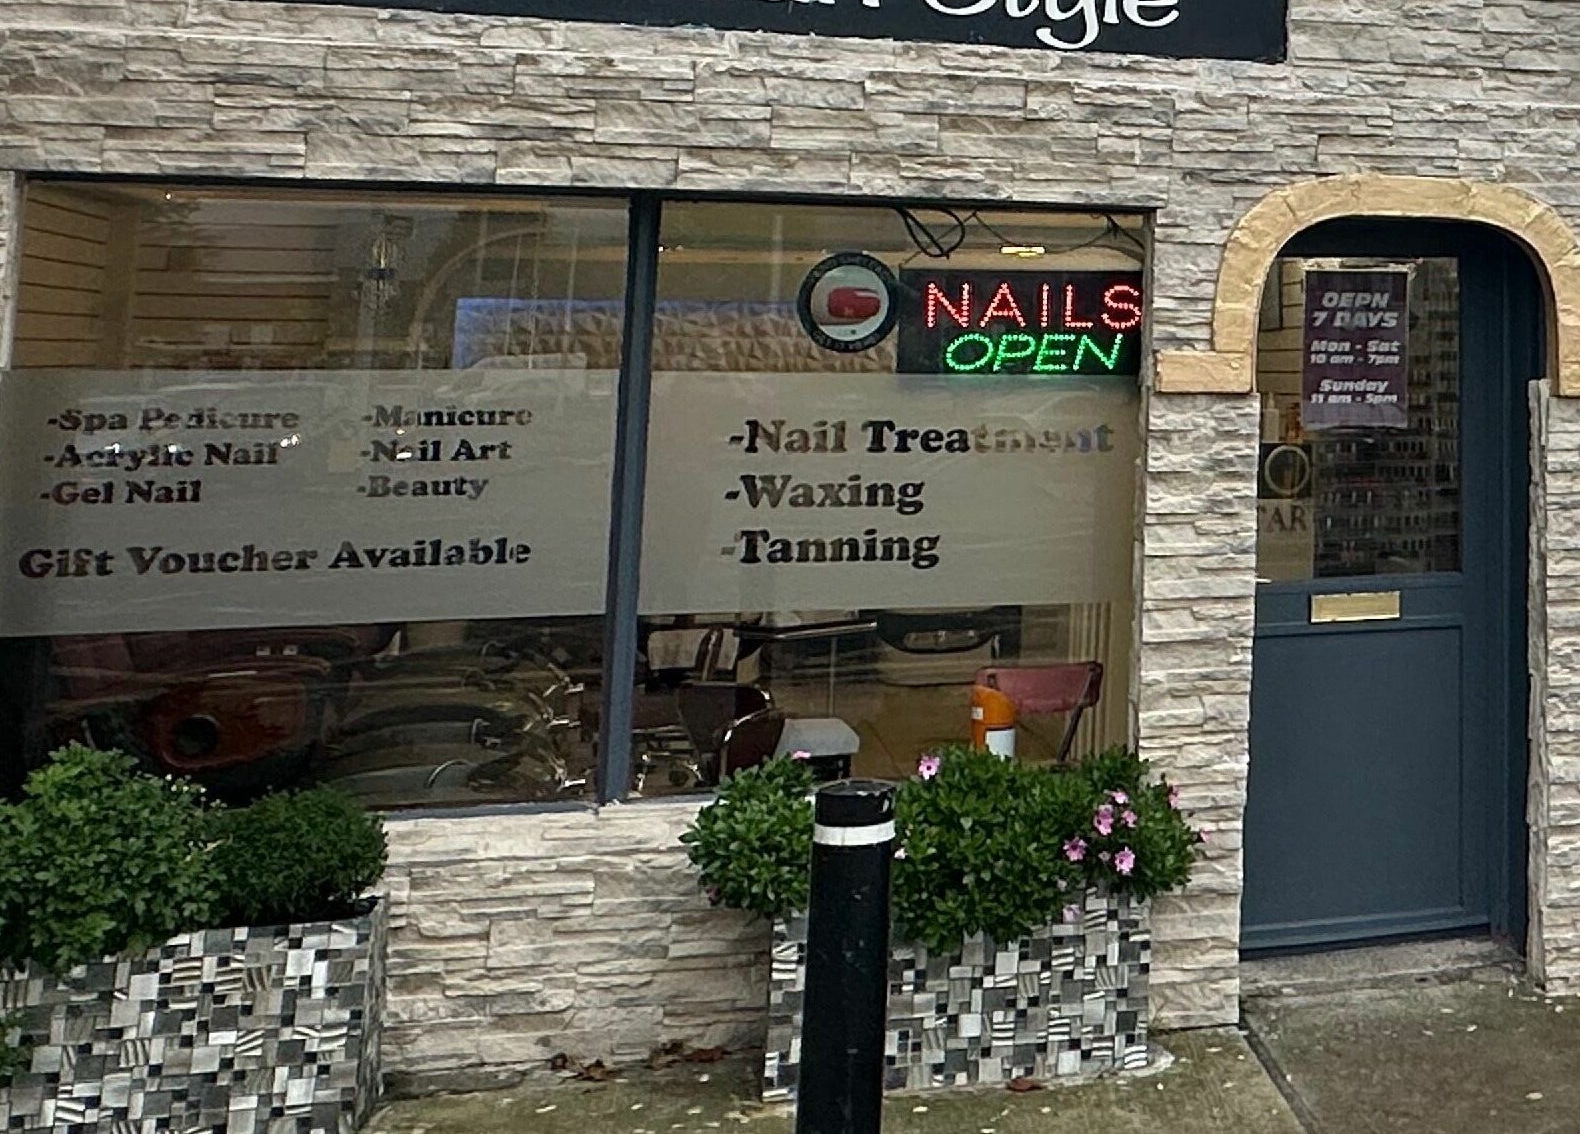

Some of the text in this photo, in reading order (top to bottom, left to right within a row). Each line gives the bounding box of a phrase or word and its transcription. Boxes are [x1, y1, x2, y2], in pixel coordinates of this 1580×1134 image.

[924, 282, 1142, 329] NAILS
[1322, 291, 1390, 308] OEPN
[1312, 311, 1399, 327] 7 DAYS
[945, 332, 1124, 372] OPEN
[1311, 340, 1351, 352] Mon
[1367, 340, 1400, 352] Sat
[1311, 353, 1326, 364] 10
[1330, 355, 1354, 364] am
[1319, 378, 1388, 393] Sunday
[139, 406, 300, 430] Pedicure
[861, 420, 1114, 454] Treatment
[204, 442, 278, 466] Nail
[451, 438, 512, 461] Art
[125, 479, 201, 503] Nail
[18, 537, 531, 578] Gift Voucher Available
